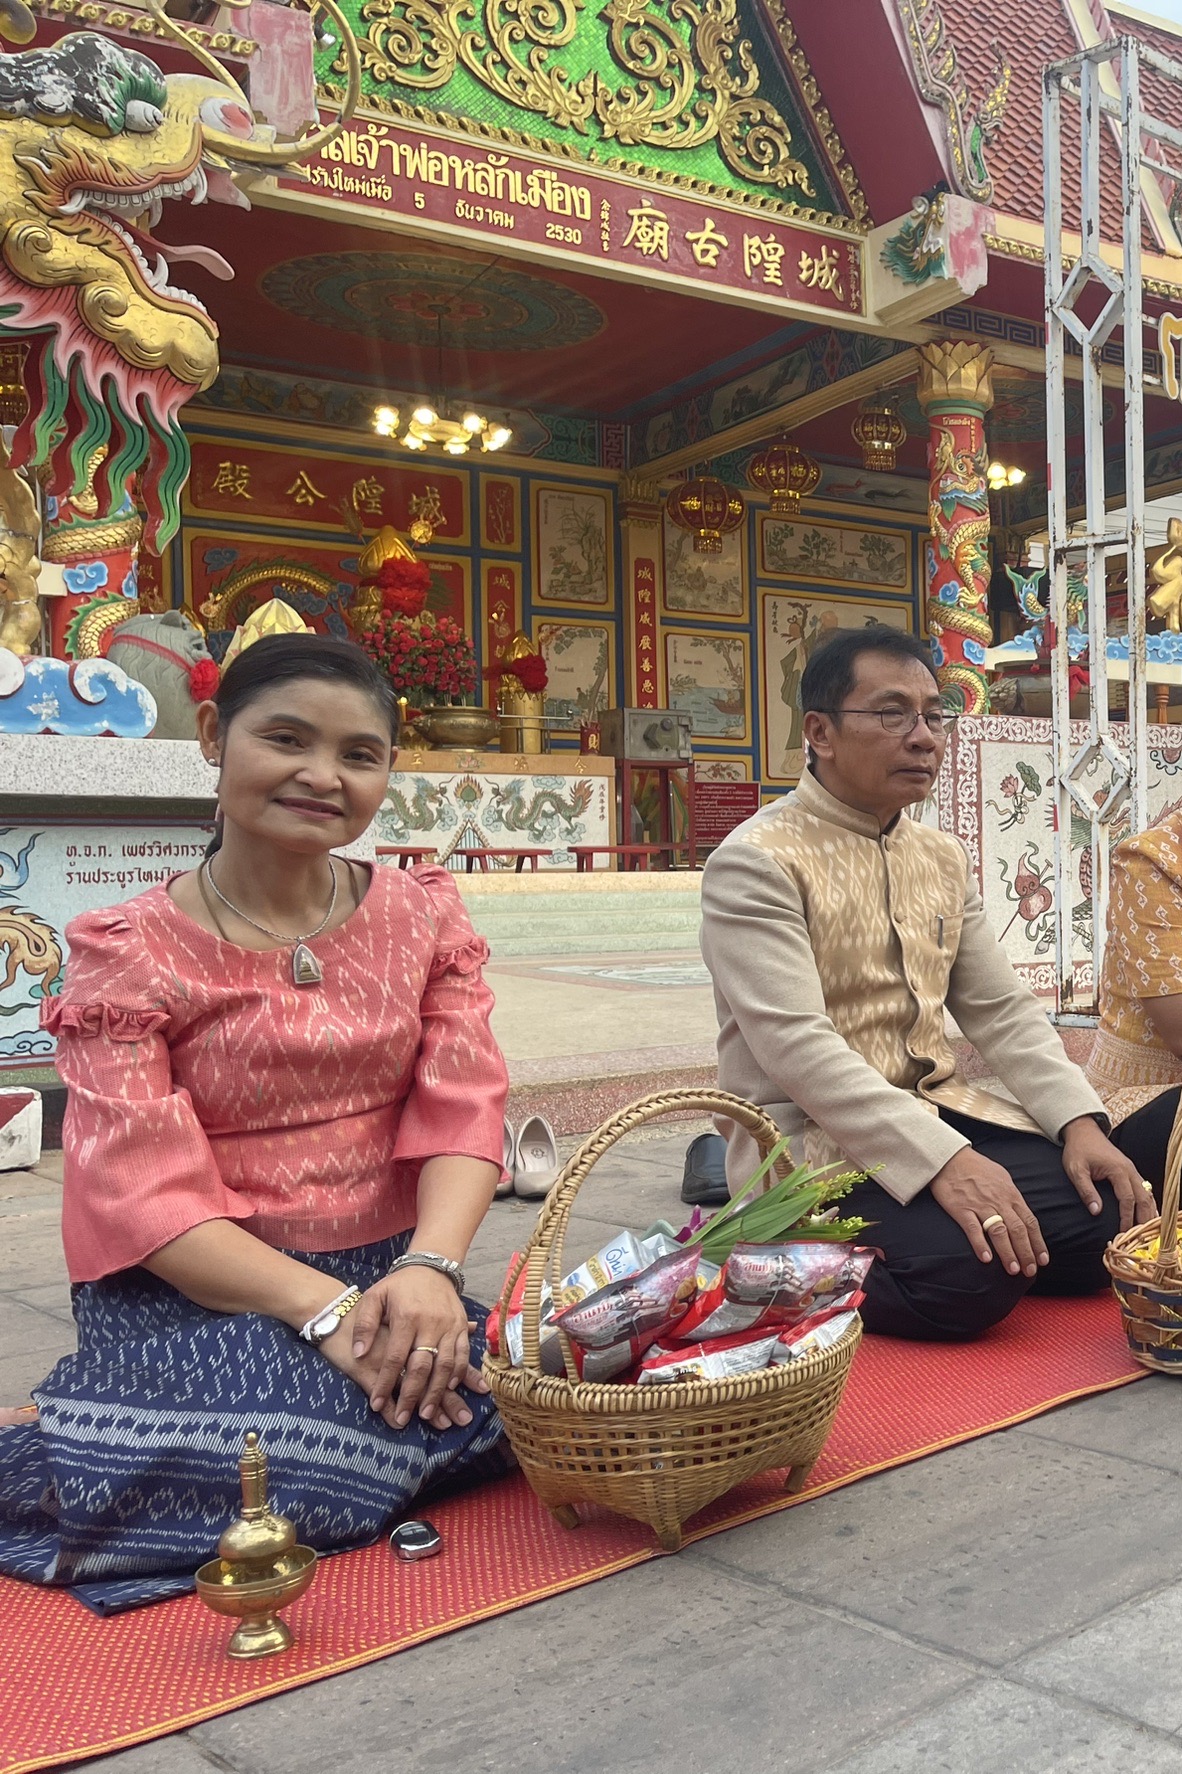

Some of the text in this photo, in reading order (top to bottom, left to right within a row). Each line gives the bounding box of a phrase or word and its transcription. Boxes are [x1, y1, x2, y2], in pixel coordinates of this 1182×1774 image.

[300, 121, 592, 221] าลเจ้าพ่อหลักเมือง
[414, 192, 425, 209] 5
[455, 198, 515, 230] ธันวาคม
[545, 222, 583, 245] 2530
[122, 840, 207, 857] เพชรวิศวกรร
